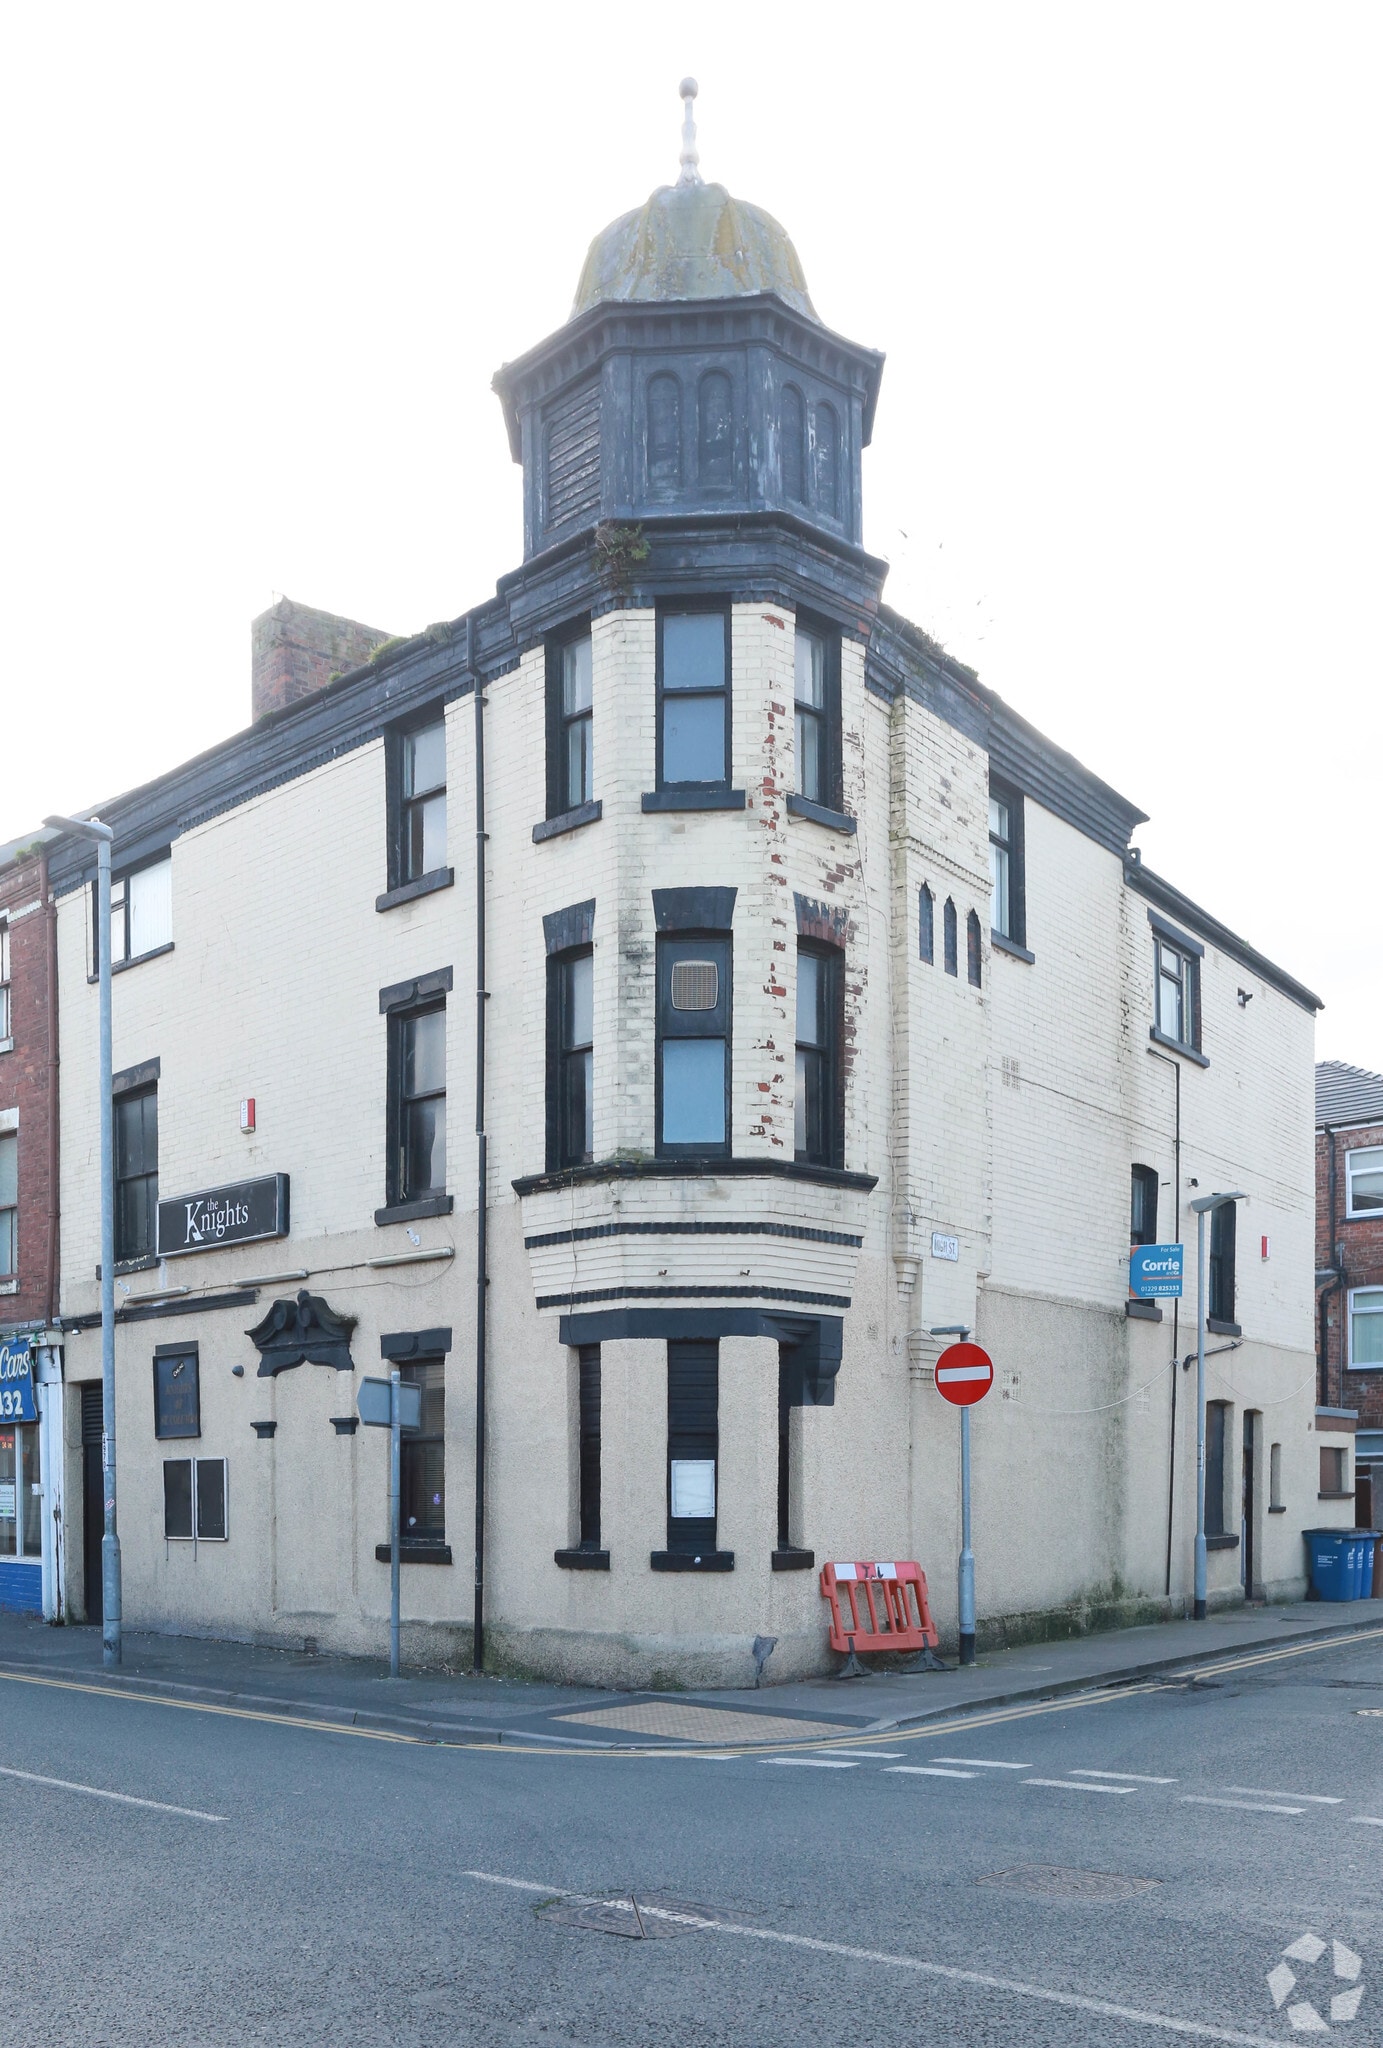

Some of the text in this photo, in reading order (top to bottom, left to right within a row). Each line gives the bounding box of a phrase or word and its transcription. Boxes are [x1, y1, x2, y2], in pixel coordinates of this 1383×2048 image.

[207, 1198, 219, 1211] the
[184, 1199, 249, 1244] Knights
[1142, 1258, 1180, 1271] Corrie
[0, 1346, 30, 1379] Cars
